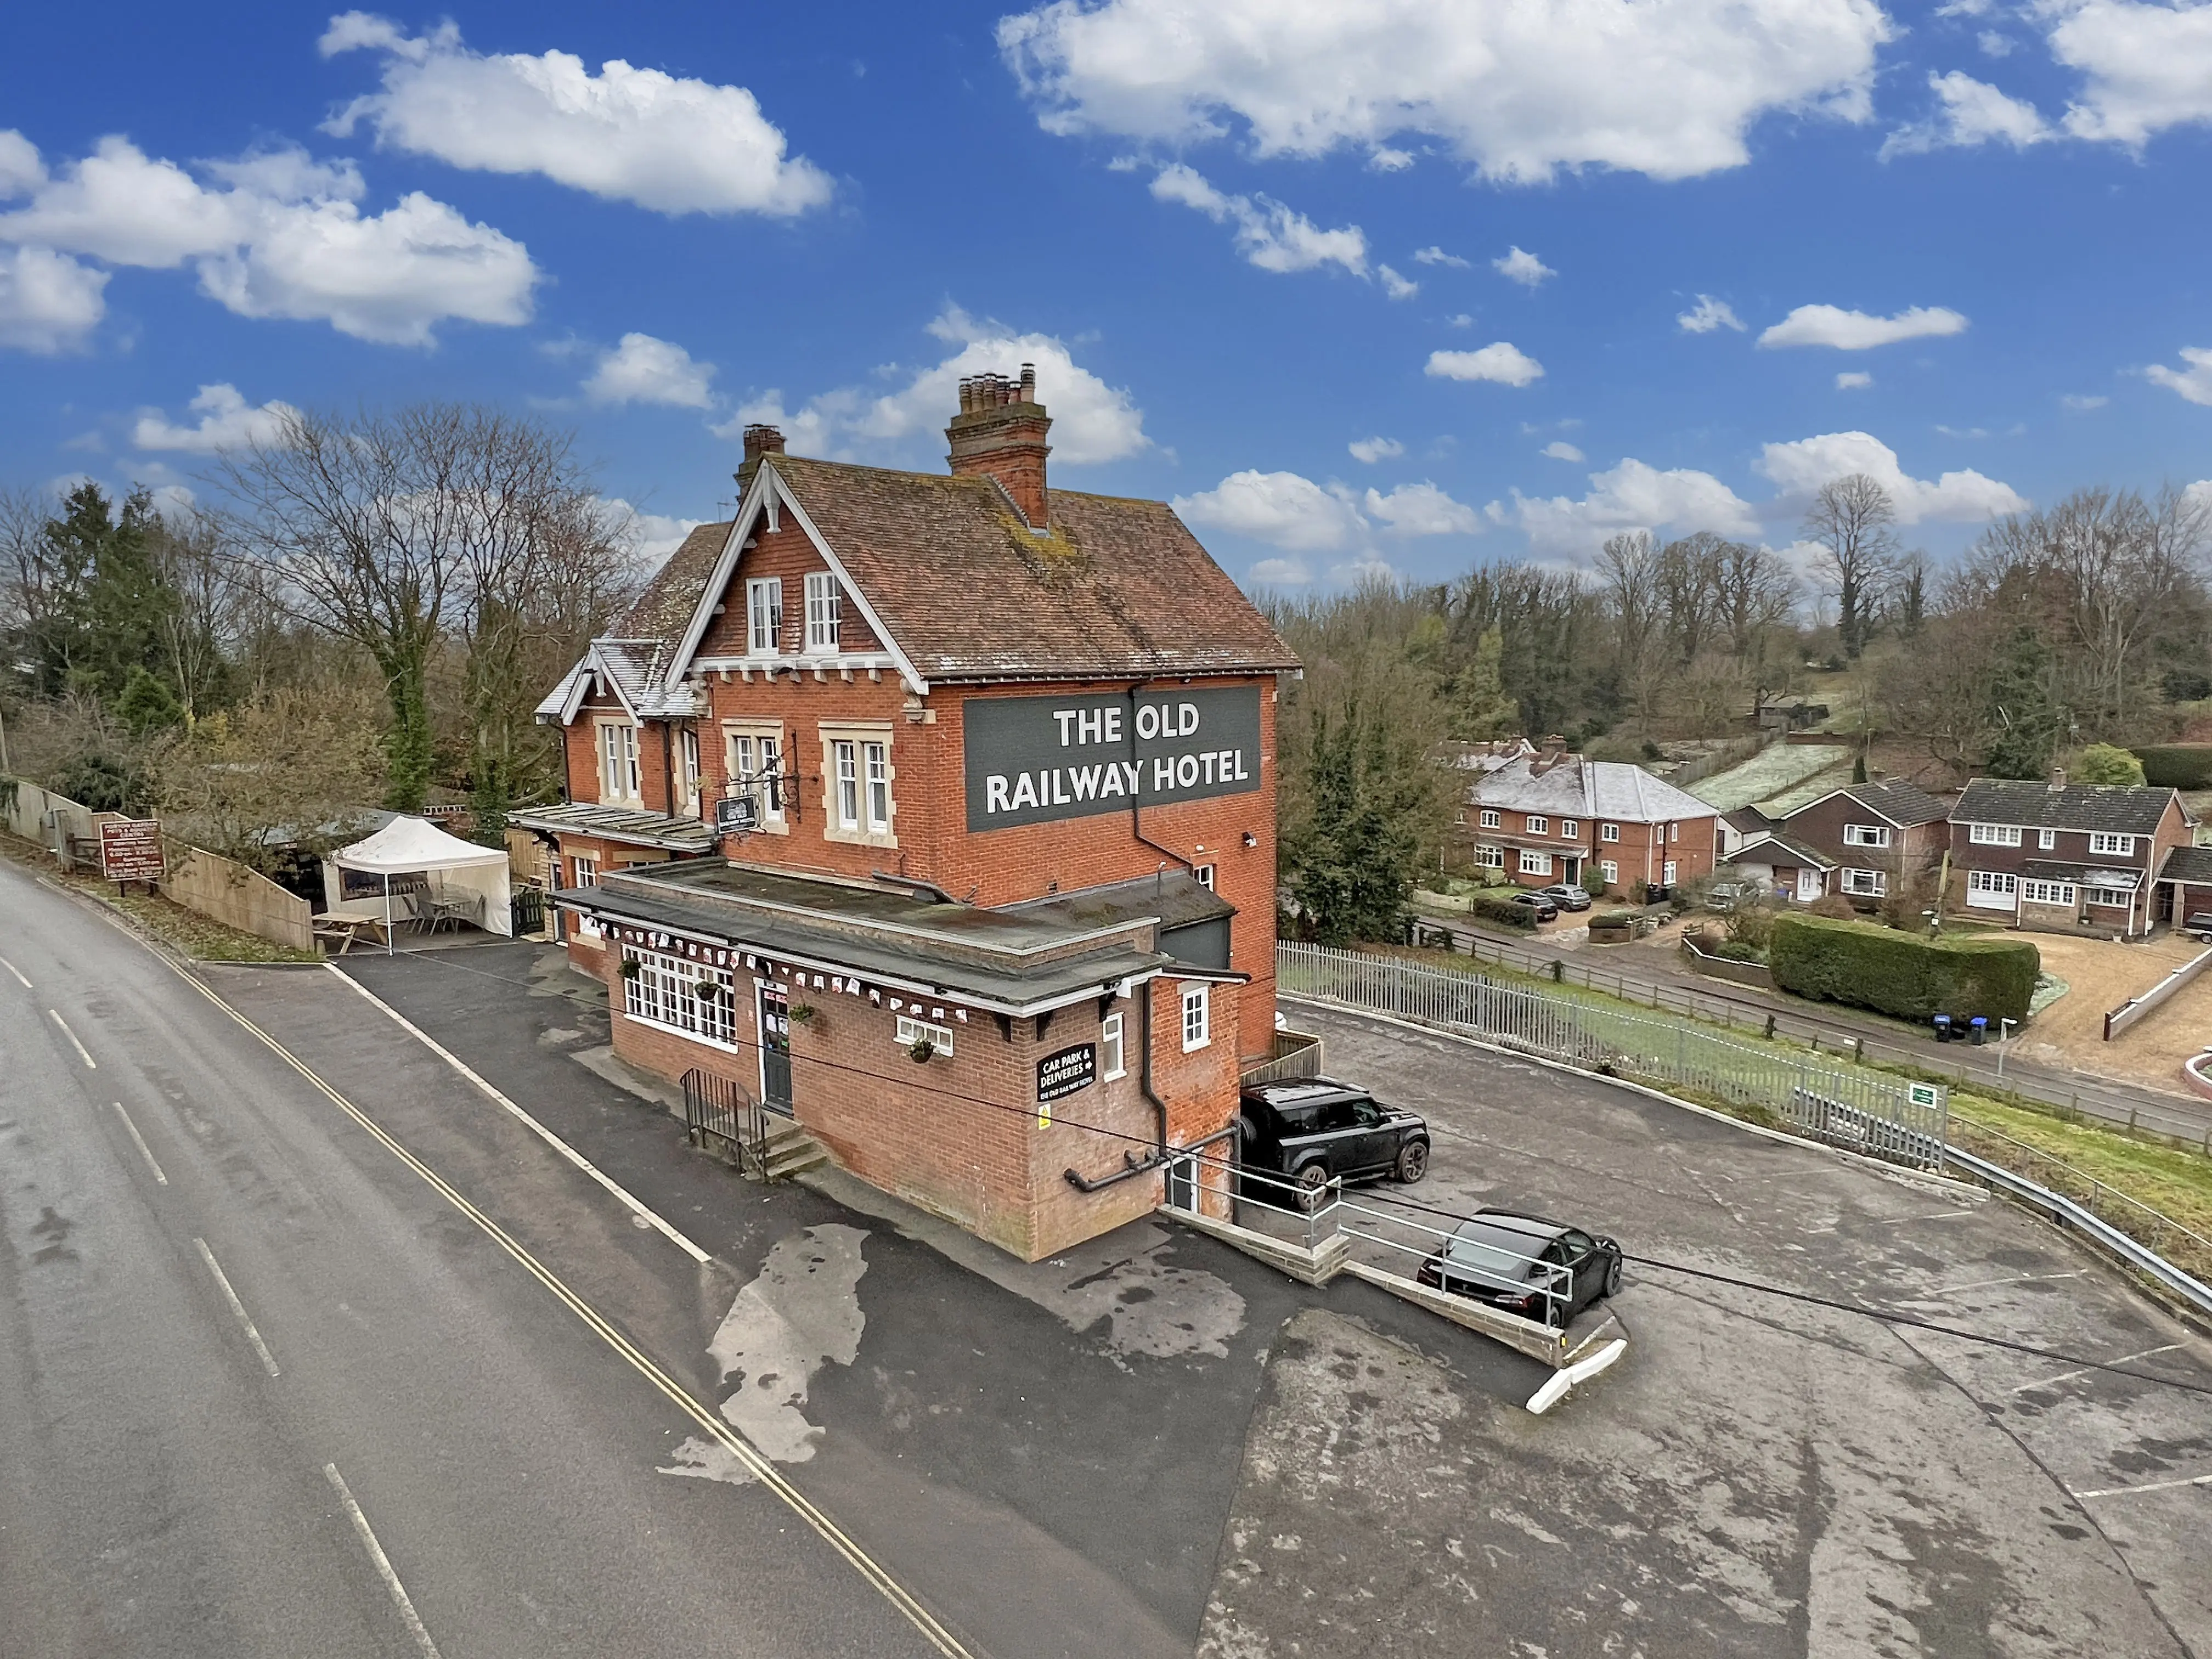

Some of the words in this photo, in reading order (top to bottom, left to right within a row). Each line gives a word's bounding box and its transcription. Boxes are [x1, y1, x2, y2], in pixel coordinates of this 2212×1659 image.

[1053, 707, 1122, 746] THE
[1136, 703, 1199, 740] OLD
[986, 759, 1144, 814] RAILWAY
[1153, 749, 1249, 792] HOTEL
[1040, 1063, 1084, 1088] DELIVERIES
[1043, 1059, 1060, 1074] CAR
[1061, 1051, 1082, 1068] PARK
[1083, 1048, 1090, 1059] &
